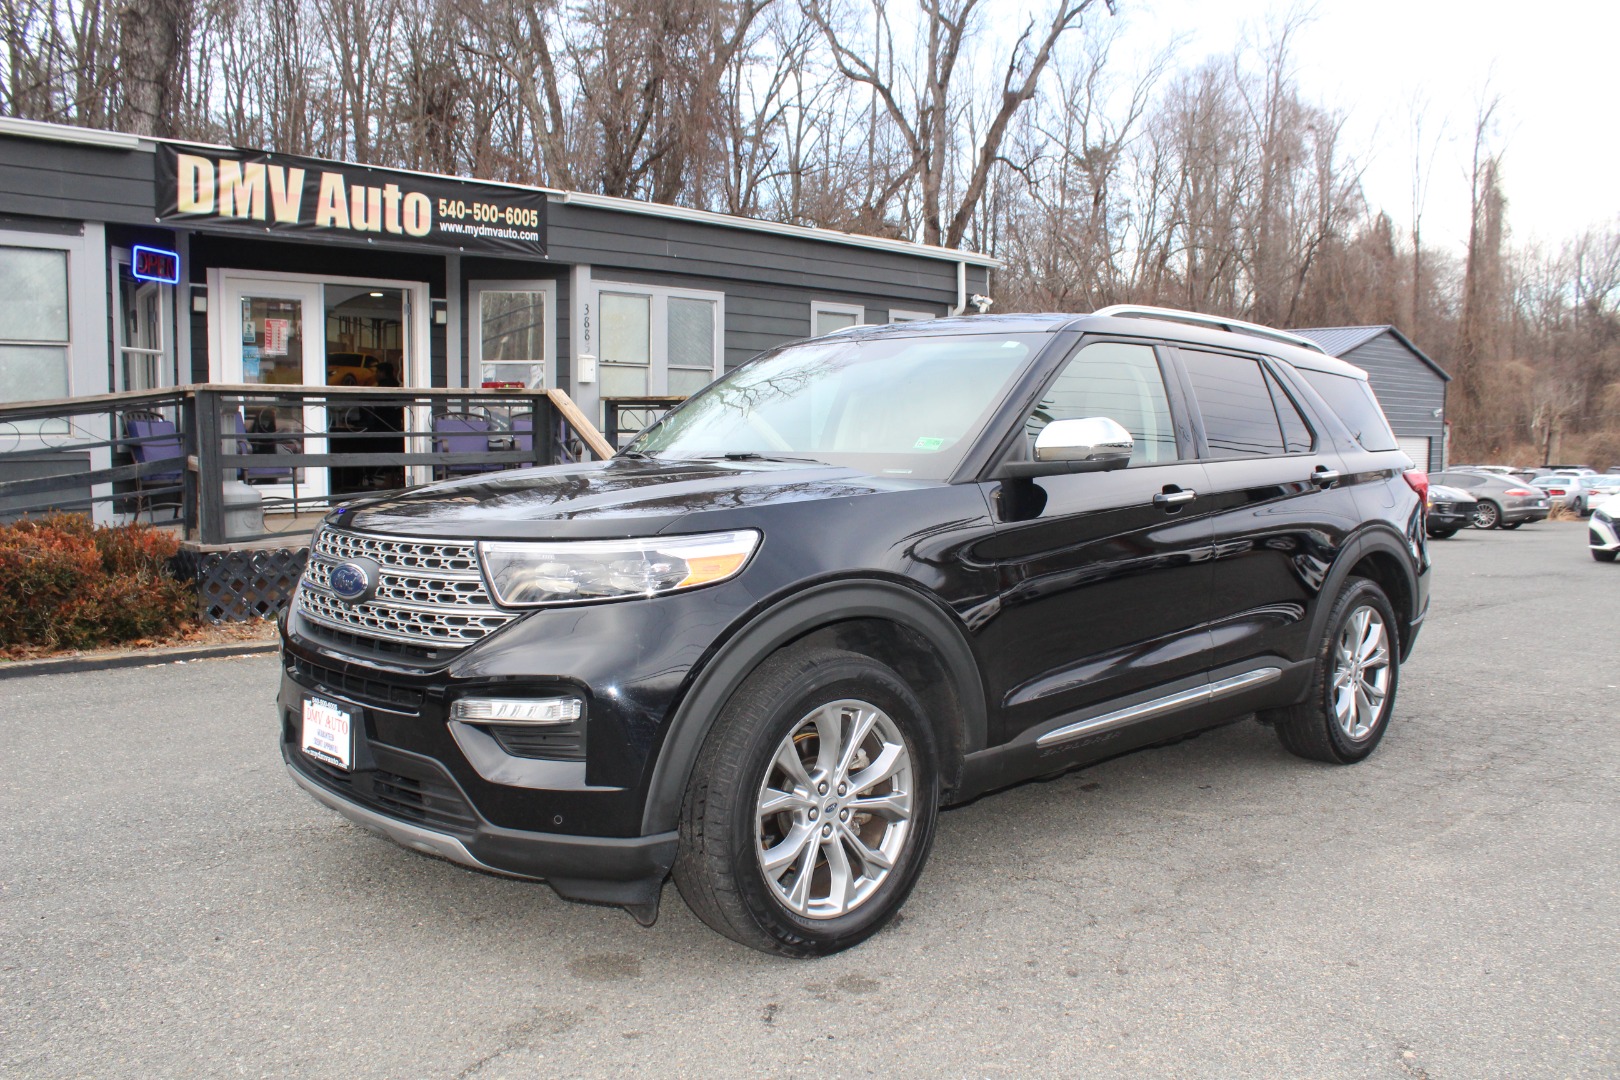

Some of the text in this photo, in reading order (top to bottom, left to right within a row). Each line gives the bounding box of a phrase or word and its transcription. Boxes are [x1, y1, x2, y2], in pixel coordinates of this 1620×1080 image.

[177, 153, 432, 237] DMV Auto
[438, 198, 538, 227] 540-500-6005
[439, 221, 539, 241] www.mydmvauto.com
[137, 251, 176, 279] OPEN
[325, 715, 349, 735] AUTO
